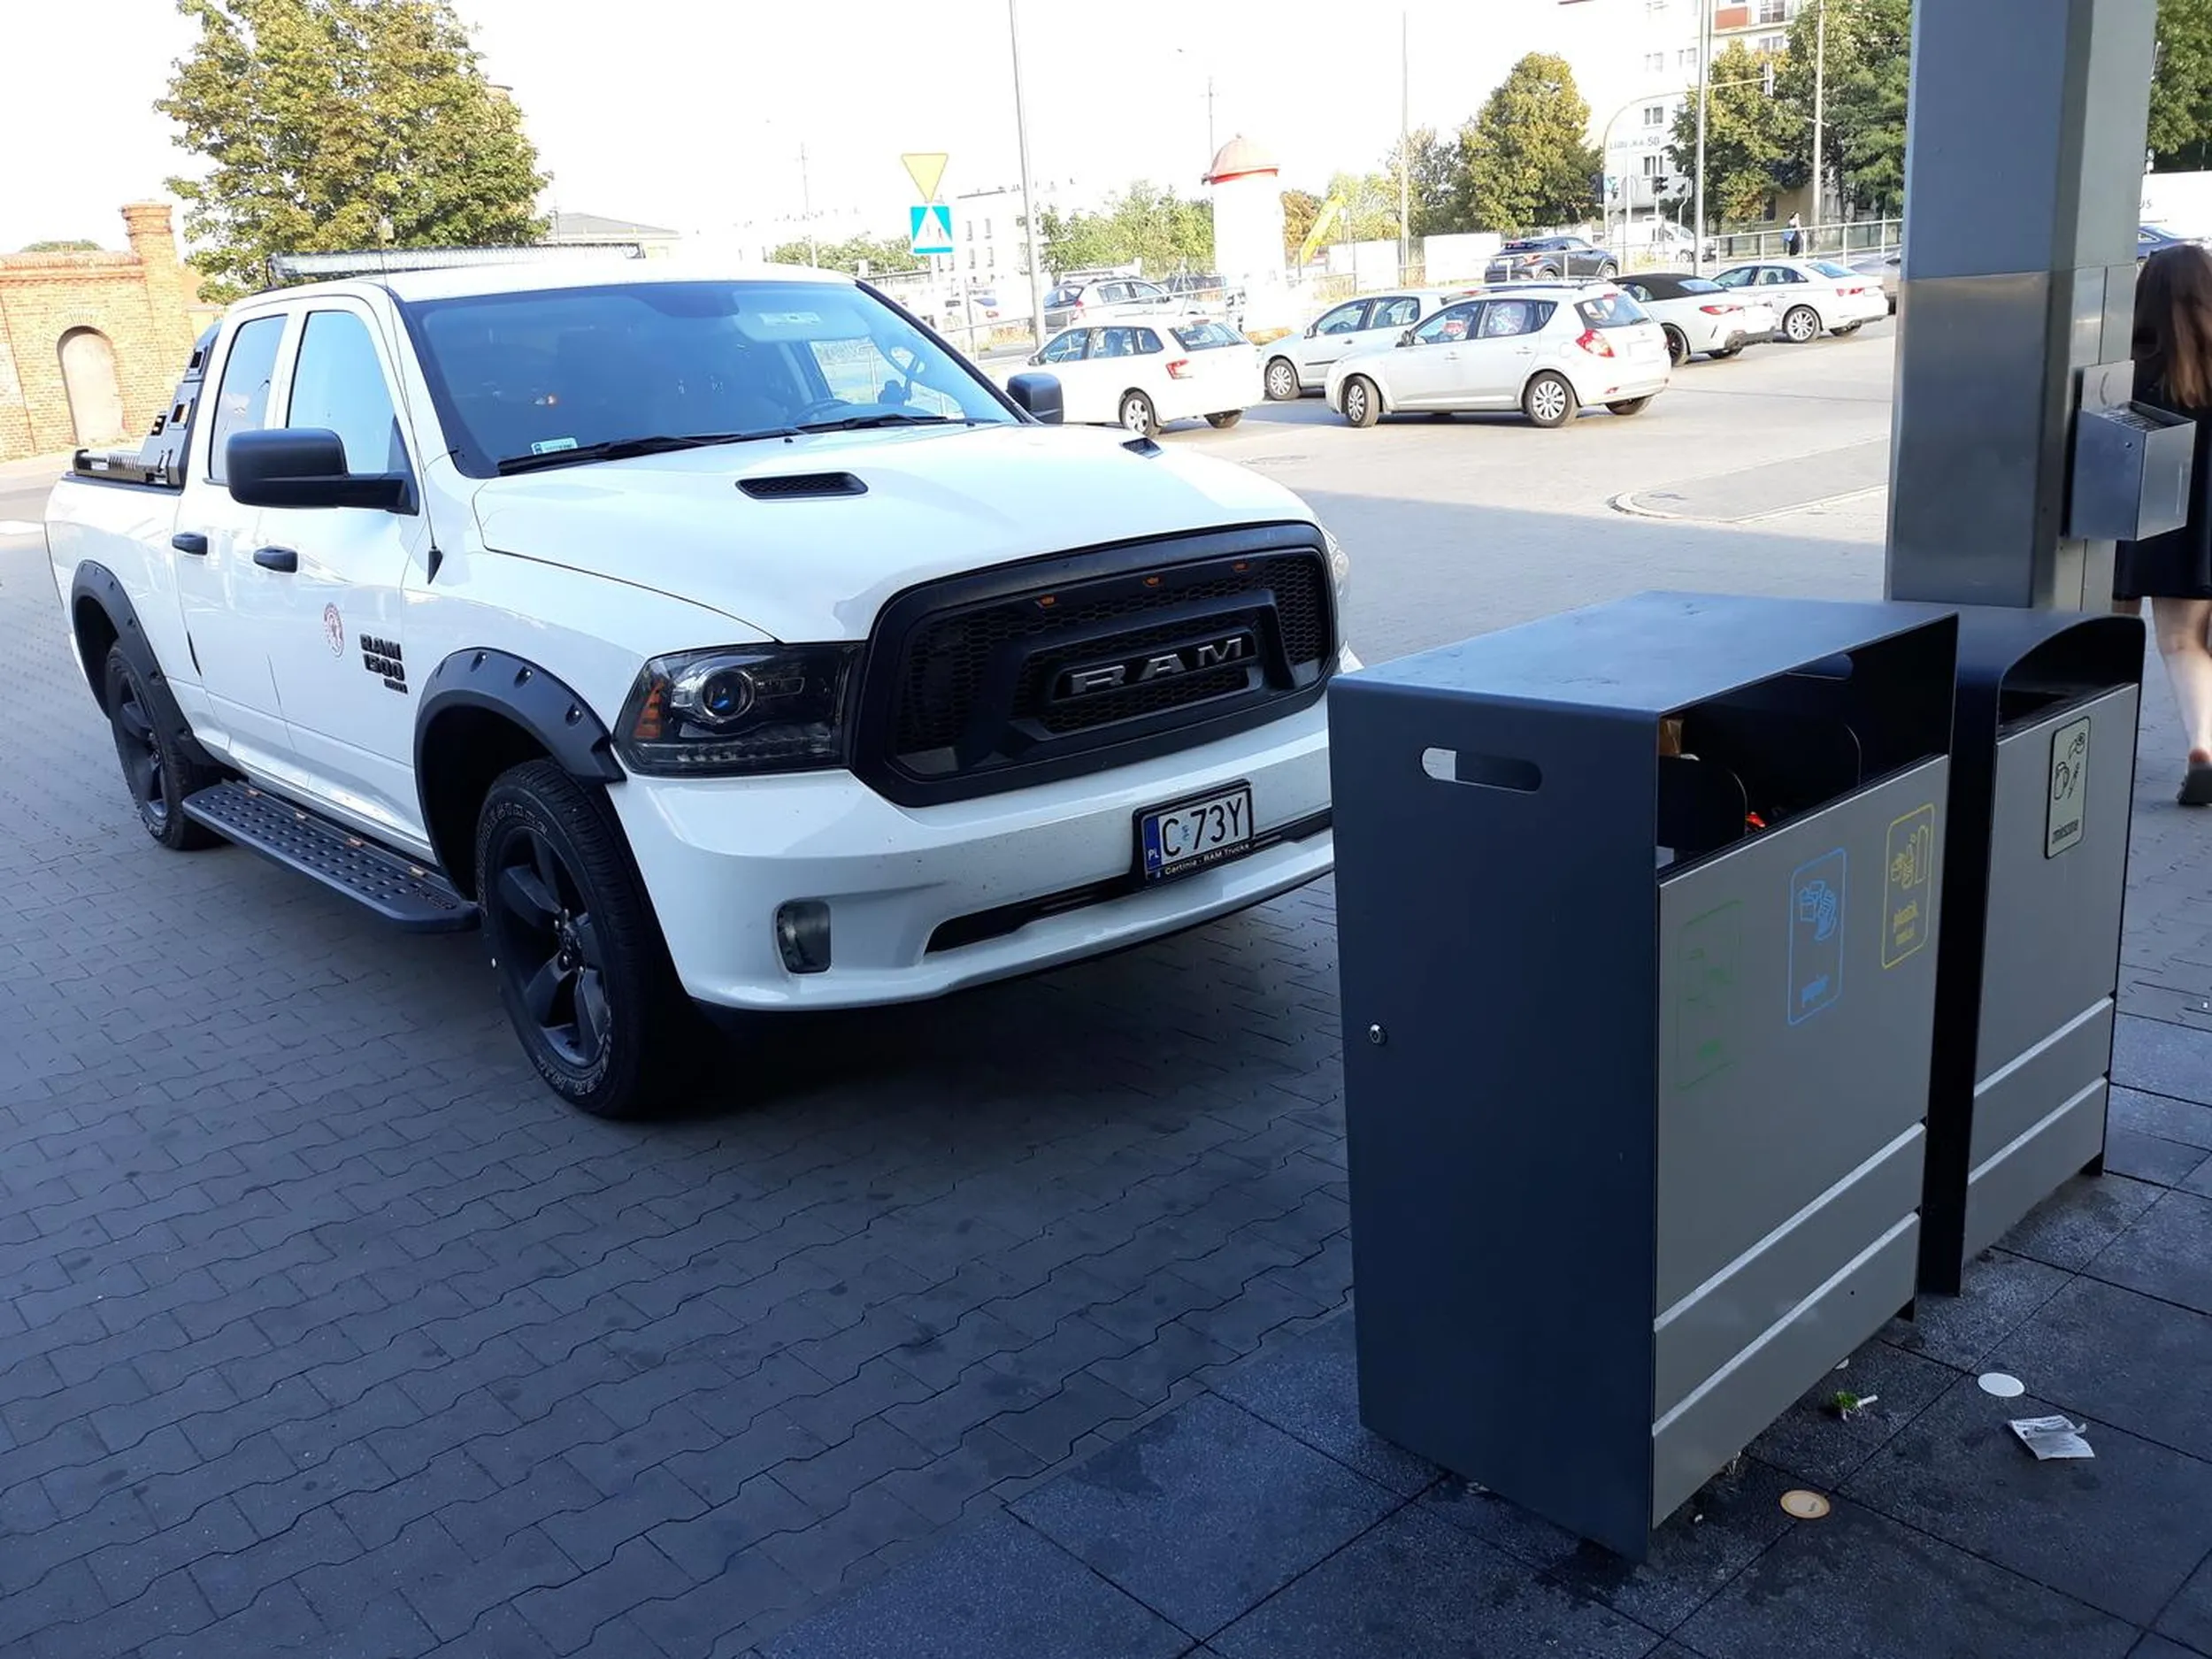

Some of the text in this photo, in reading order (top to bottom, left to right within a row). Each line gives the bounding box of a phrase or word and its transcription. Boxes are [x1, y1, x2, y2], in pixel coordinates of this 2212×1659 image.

[359, 634, 403, 662] RAM
[1071, 637, 1242, 695] RAM
[1148, 849, 1159, 861] PL
